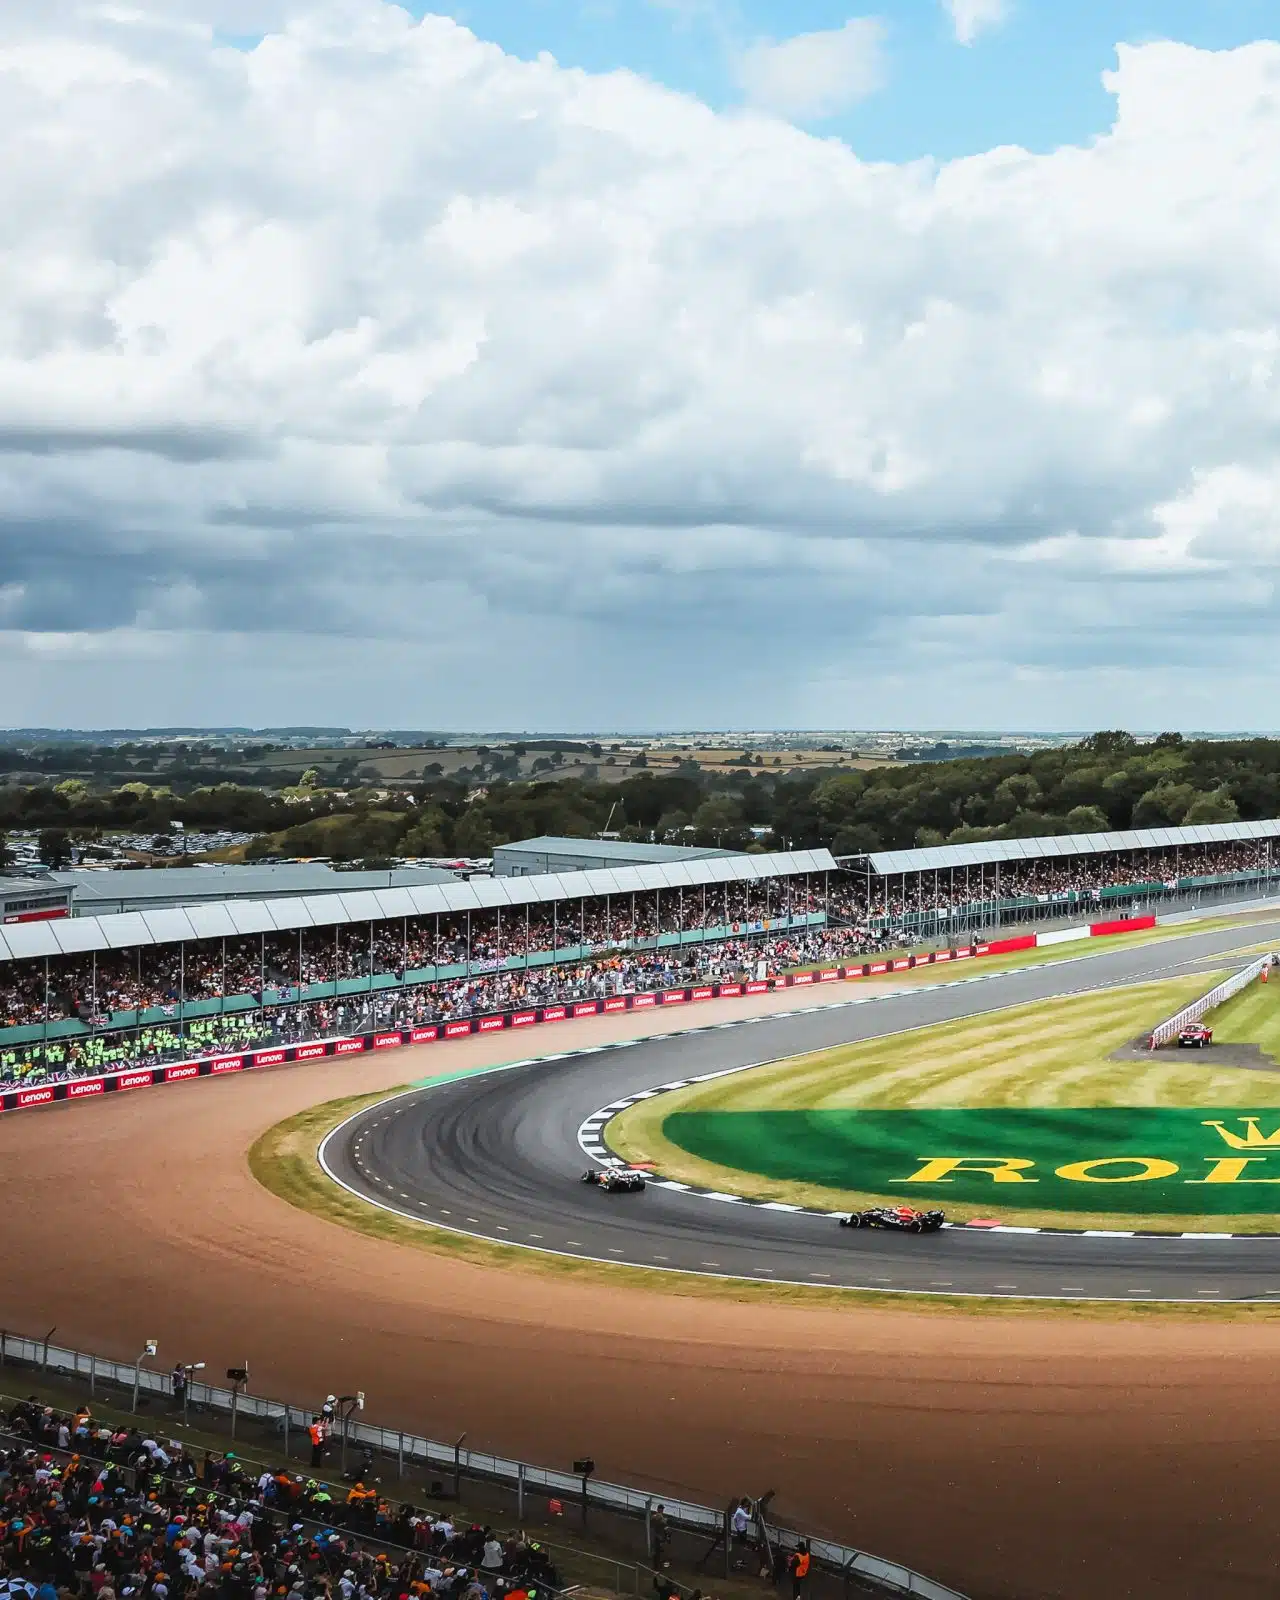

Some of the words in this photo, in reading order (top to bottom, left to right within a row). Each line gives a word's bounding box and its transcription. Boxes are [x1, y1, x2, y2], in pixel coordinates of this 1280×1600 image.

[693, 989, 712, 998] Lenovo
[575, 1005, 595, 1015] Lenovo
[605, 1001, 624, 1010] Lenovo
[513, 1015, 534, 1024] Lenovo
[545, 1010, 564, 1020] Lenovo
[481, 1019, 502, 1029] Lenovo
[447, 1025, 469, 1035] Lenovo
[413, 1030, 435, 1041] Lenovo
[337, 1041, 362, 1051] Lenovo
[376, 1036, 399, 1046] Lenovo
[298, 1047, 323, 1057] Lenovo
[257, 1053, 283, 1064] Lenovo
[213, 1060, 241, 1070] Lenovo
[168, 1067, 196, 1079] Lenovo
[121, 1074, 150, 1087] Lenovo
[70, 1083, 101, 1095] Lenovo
[20, 1092, 51, 1103] Lenovo
